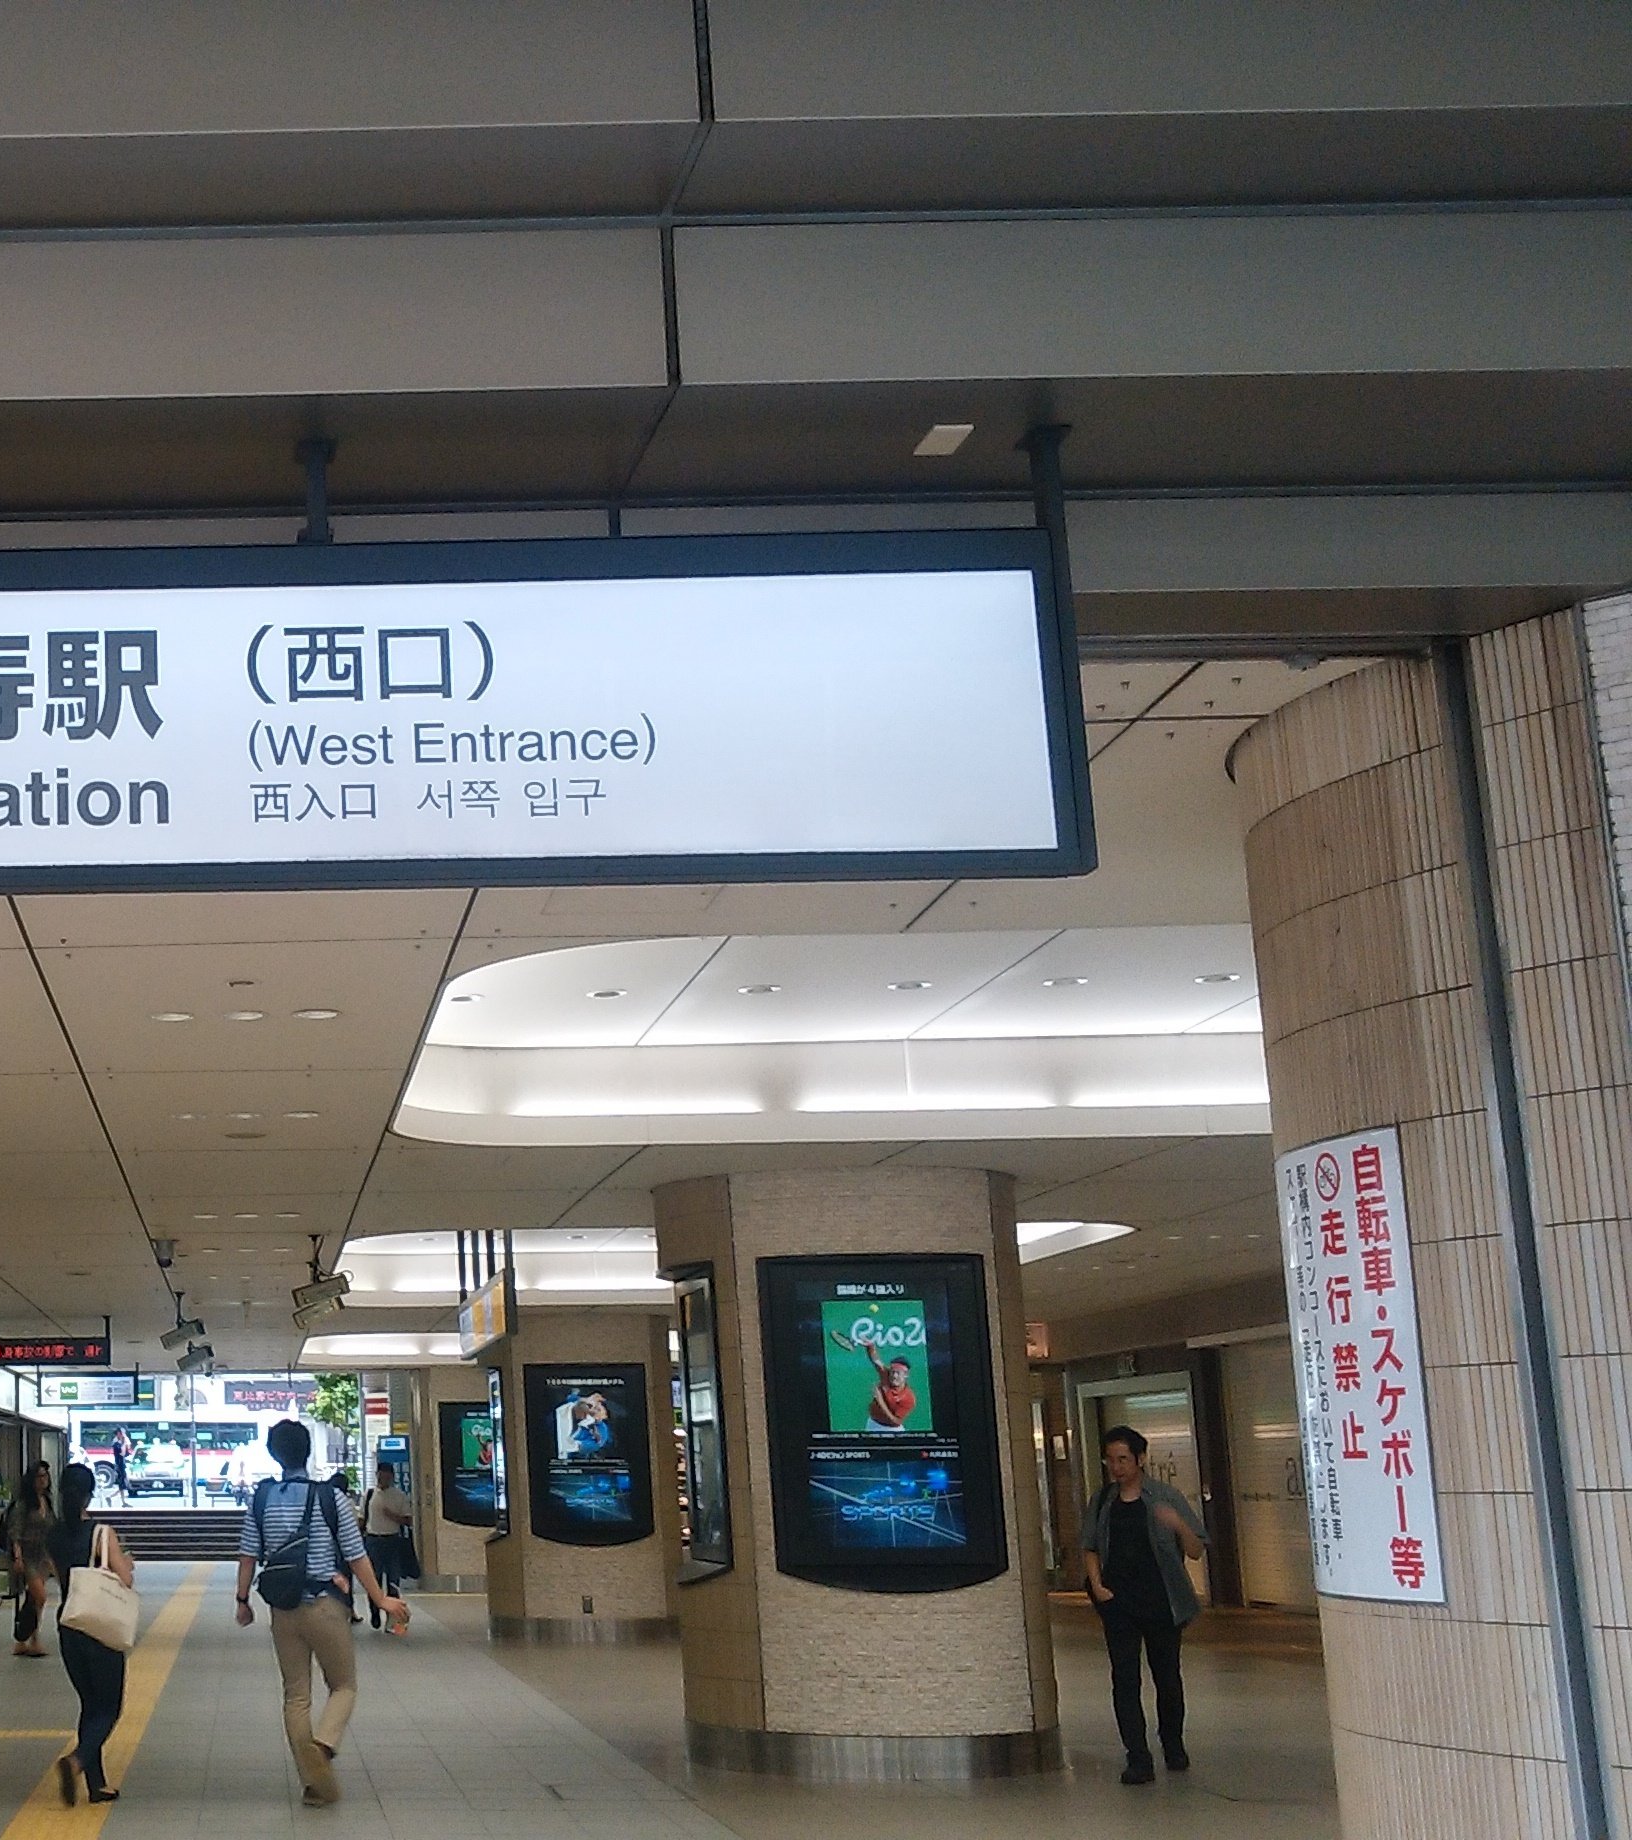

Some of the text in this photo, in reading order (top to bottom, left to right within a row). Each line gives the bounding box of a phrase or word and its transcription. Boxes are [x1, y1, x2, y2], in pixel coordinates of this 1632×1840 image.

[249, 712, 656, 773] (West Entrance)
[249, 777, 607, 823] 西入口 서쪽 입구
[849, 1316, 927, 1347] Rio2
[1319, 1208, 1369, 1462] 走行禁止
[1351, 1143, 1426, 1590] 自転車・スケボー等
